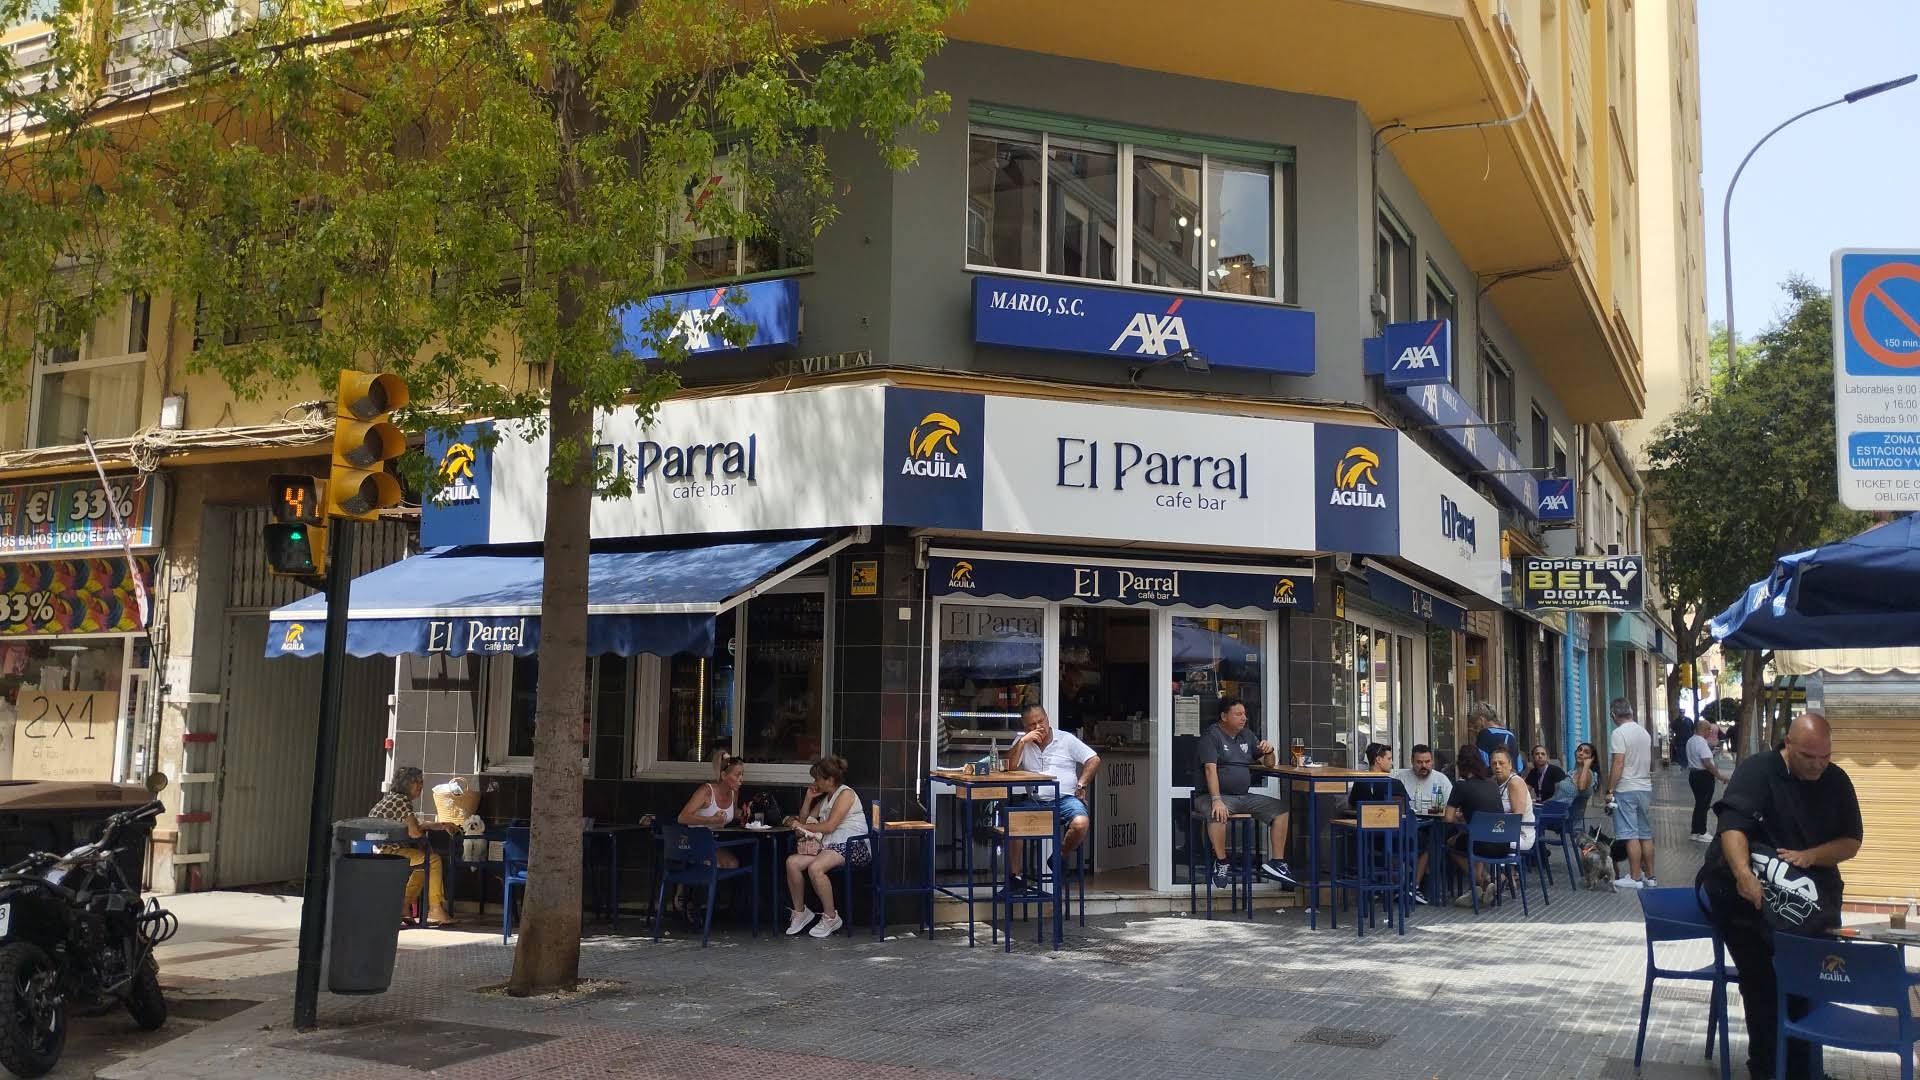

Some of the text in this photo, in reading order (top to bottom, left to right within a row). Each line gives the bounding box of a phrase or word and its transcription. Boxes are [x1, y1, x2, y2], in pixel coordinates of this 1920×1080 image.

[990, 291, 1086, 317] MARIO, S.C.
[1109, 312, 1193, 357] AXA
[1884, 338, 1900, 348] 150
[1391, 345, 1440, 370] AXA
[1845, 384, 1894, 394] Laborables
[1884, 400, 1918, 411] y 16:00
[1884, 434, 1914, 444] ZONA
[934, 452, 945, 462] EL
[1856, 446, 1920, 456] ESTACIONA
[636, 433, 757, 490] Parral
[901, 457, 967, 479] ÁGUILA
[1056, 437, 1249, 499] El Parral
[1852, 457, 1903, 467] LIMITADO
[1905, 457, 1912, 467] Y
[673, 480, 737, 499] cafe bar
[1357, 483, 1367, 492] EL
[1856, 480, 1893, 489] TICKET
[1896, 480, 1910, 489] DE
[70, 485, 133, 521] 33%
[1155, 491, 1227, 511] cafe bar
[1329, 488, 1386, 508] ÁGUILA
[1538, 495, 1569, 510] AXA
[18, 533, 53, 547] BAJOS
[56, 531, 87, 544] TODO
[89, 530, 104, 541] EL
[1528, 558, 1638, 570] COPISTERÍA
[1073, 568, 1180, 598] El Parral
[1528, 570, 1638, 590] BELY
[1156, 591, 1170, 600] bar
[1543, 590, 1623, 600] DIGITAL
[0, 592, 54, 622] 33%
[951, 611, 971, 635] El
[428, 618, 525, 651] El Parral
[502, 641, 516, 651] bar
[1107, 762, 1136, 788] SABOREA
[1109, 793, 1119, 817] TU
